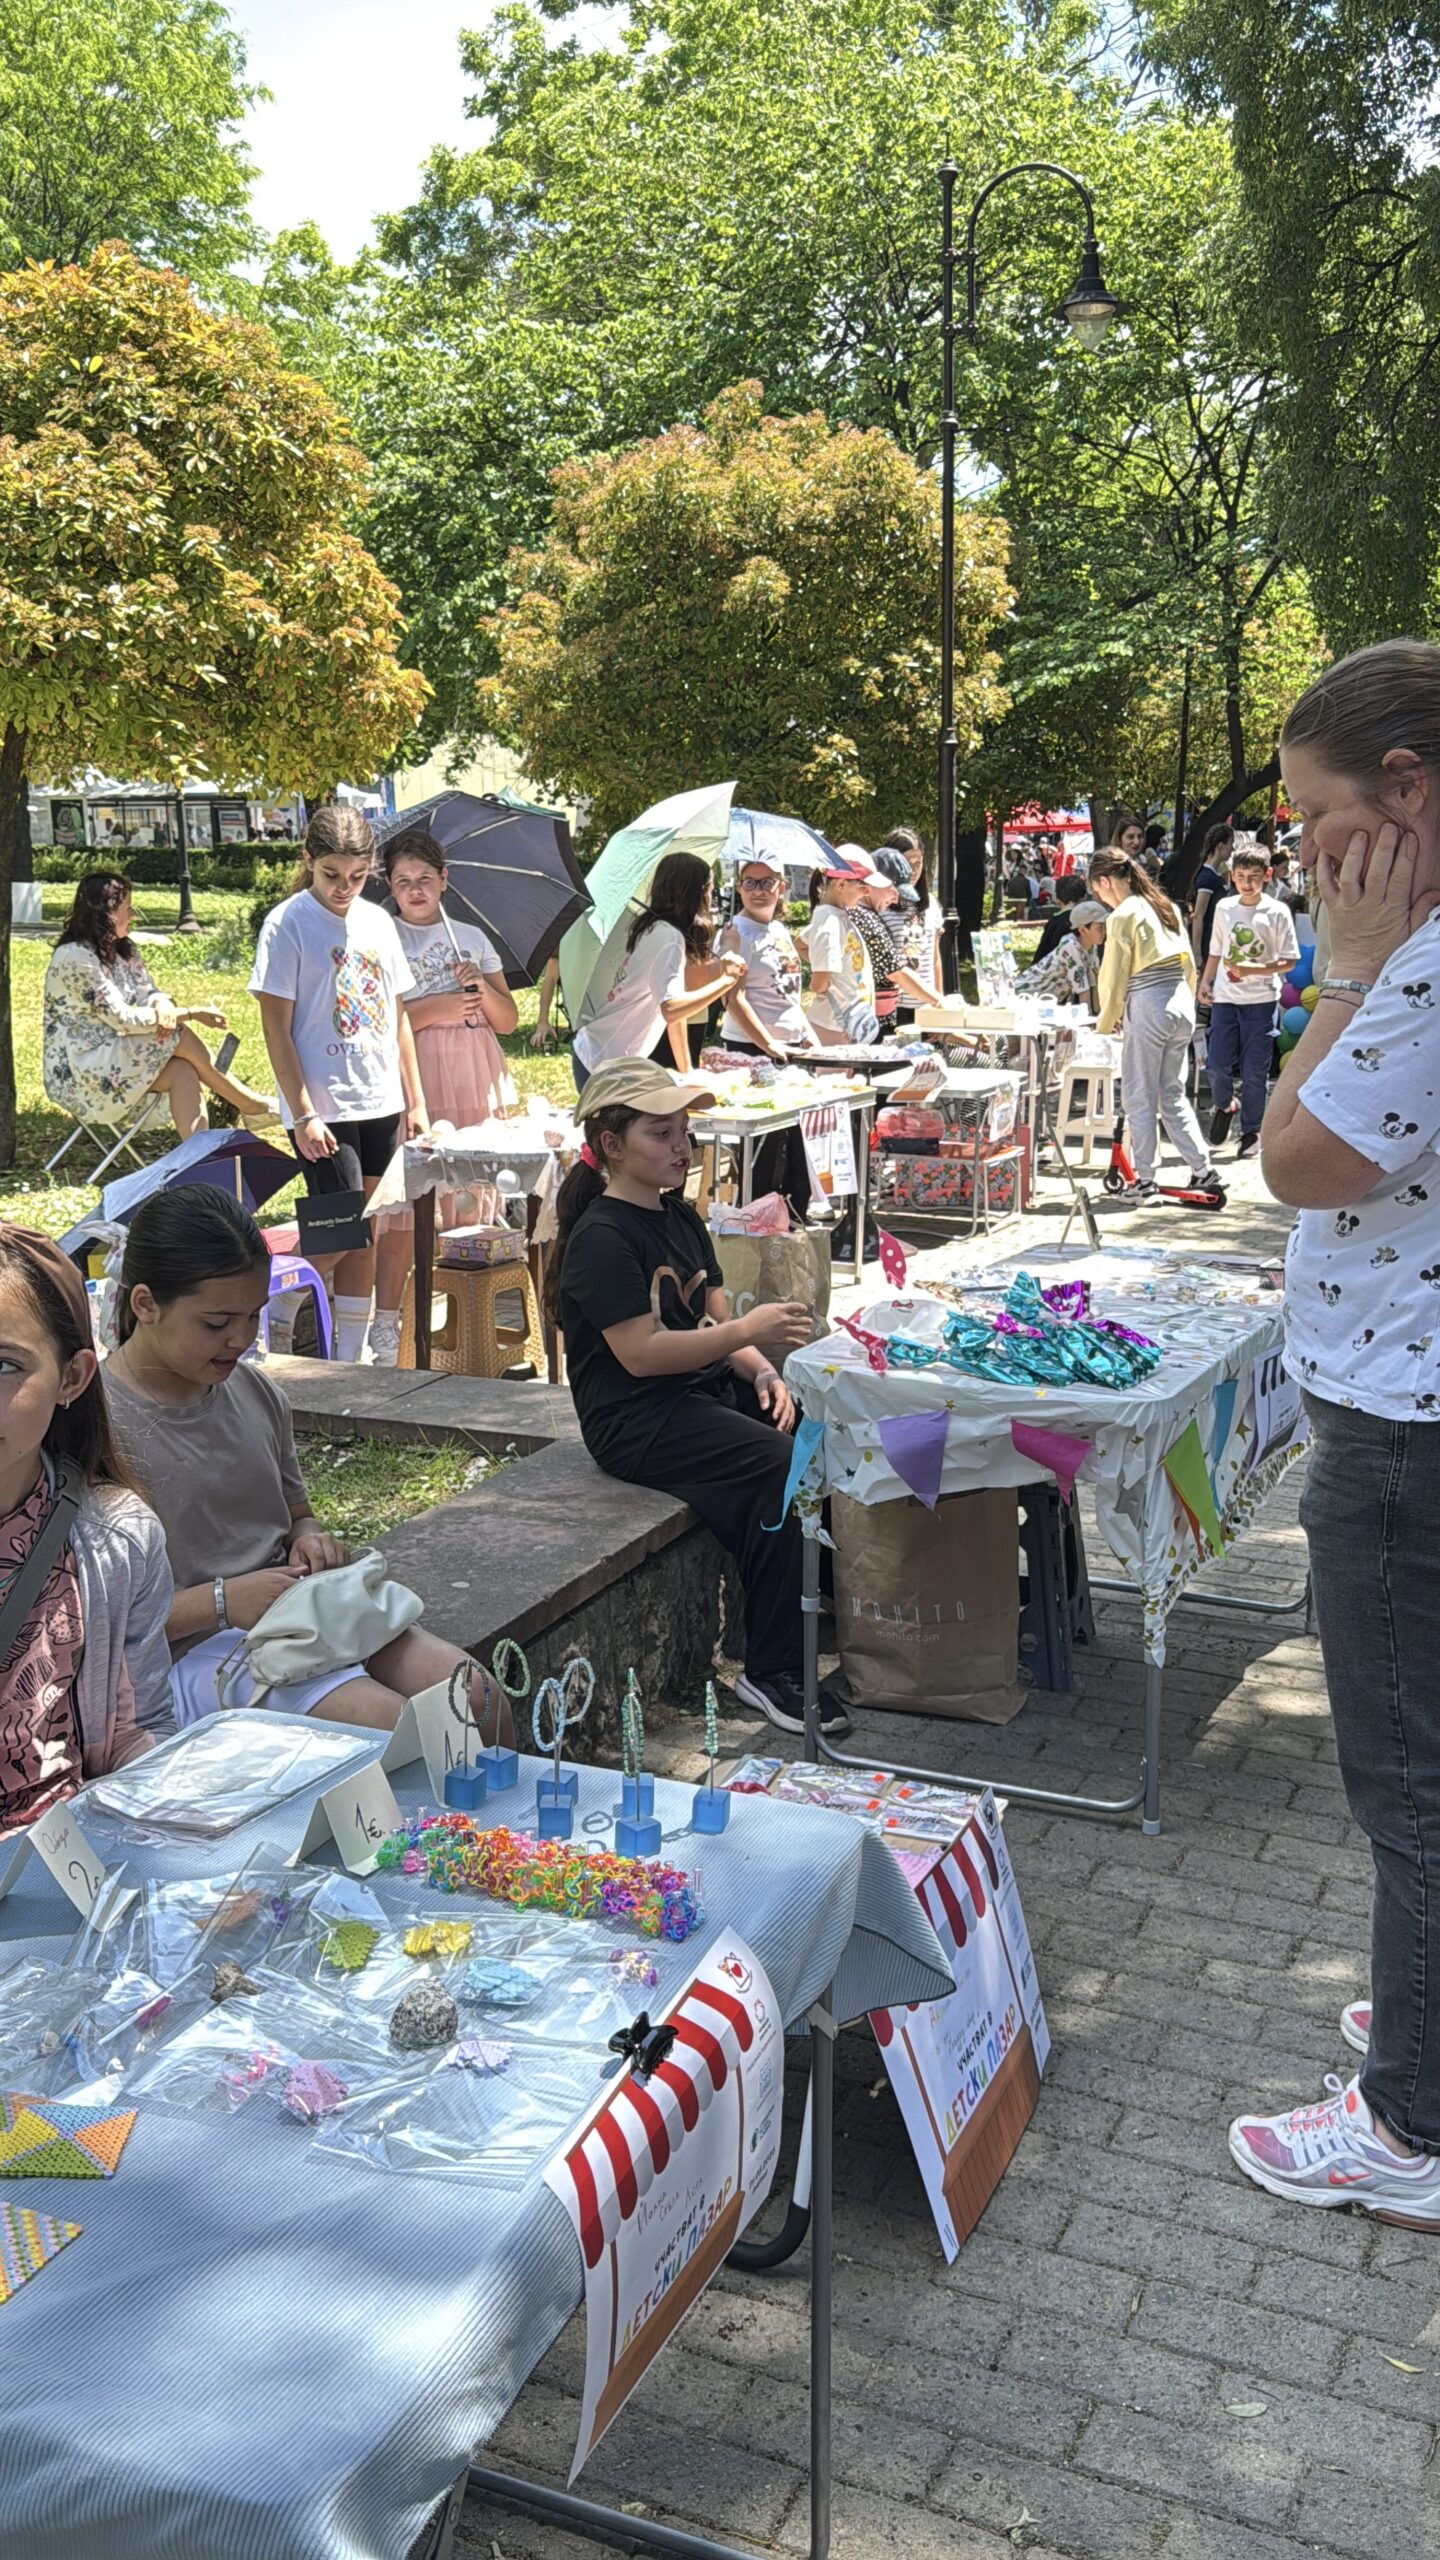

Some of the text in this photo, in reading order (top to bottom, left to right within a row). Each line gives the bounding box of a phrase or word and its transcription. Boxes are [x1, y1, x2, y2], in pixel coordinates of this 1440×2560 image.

[852, 1596, 965, 1625] MOHITO
[945, 2060, 989, 2145] ДЕТСКИ
[986, 2002, 1017, 2074] ПАЗАР
[957, 2018, 988, 2074] УЧАСТВАТ
[619, 2175, 733, 2356] ДЕТСКИ ПАЗАР
[654, 2204, 698, 2275] УЧАСТВАТ
